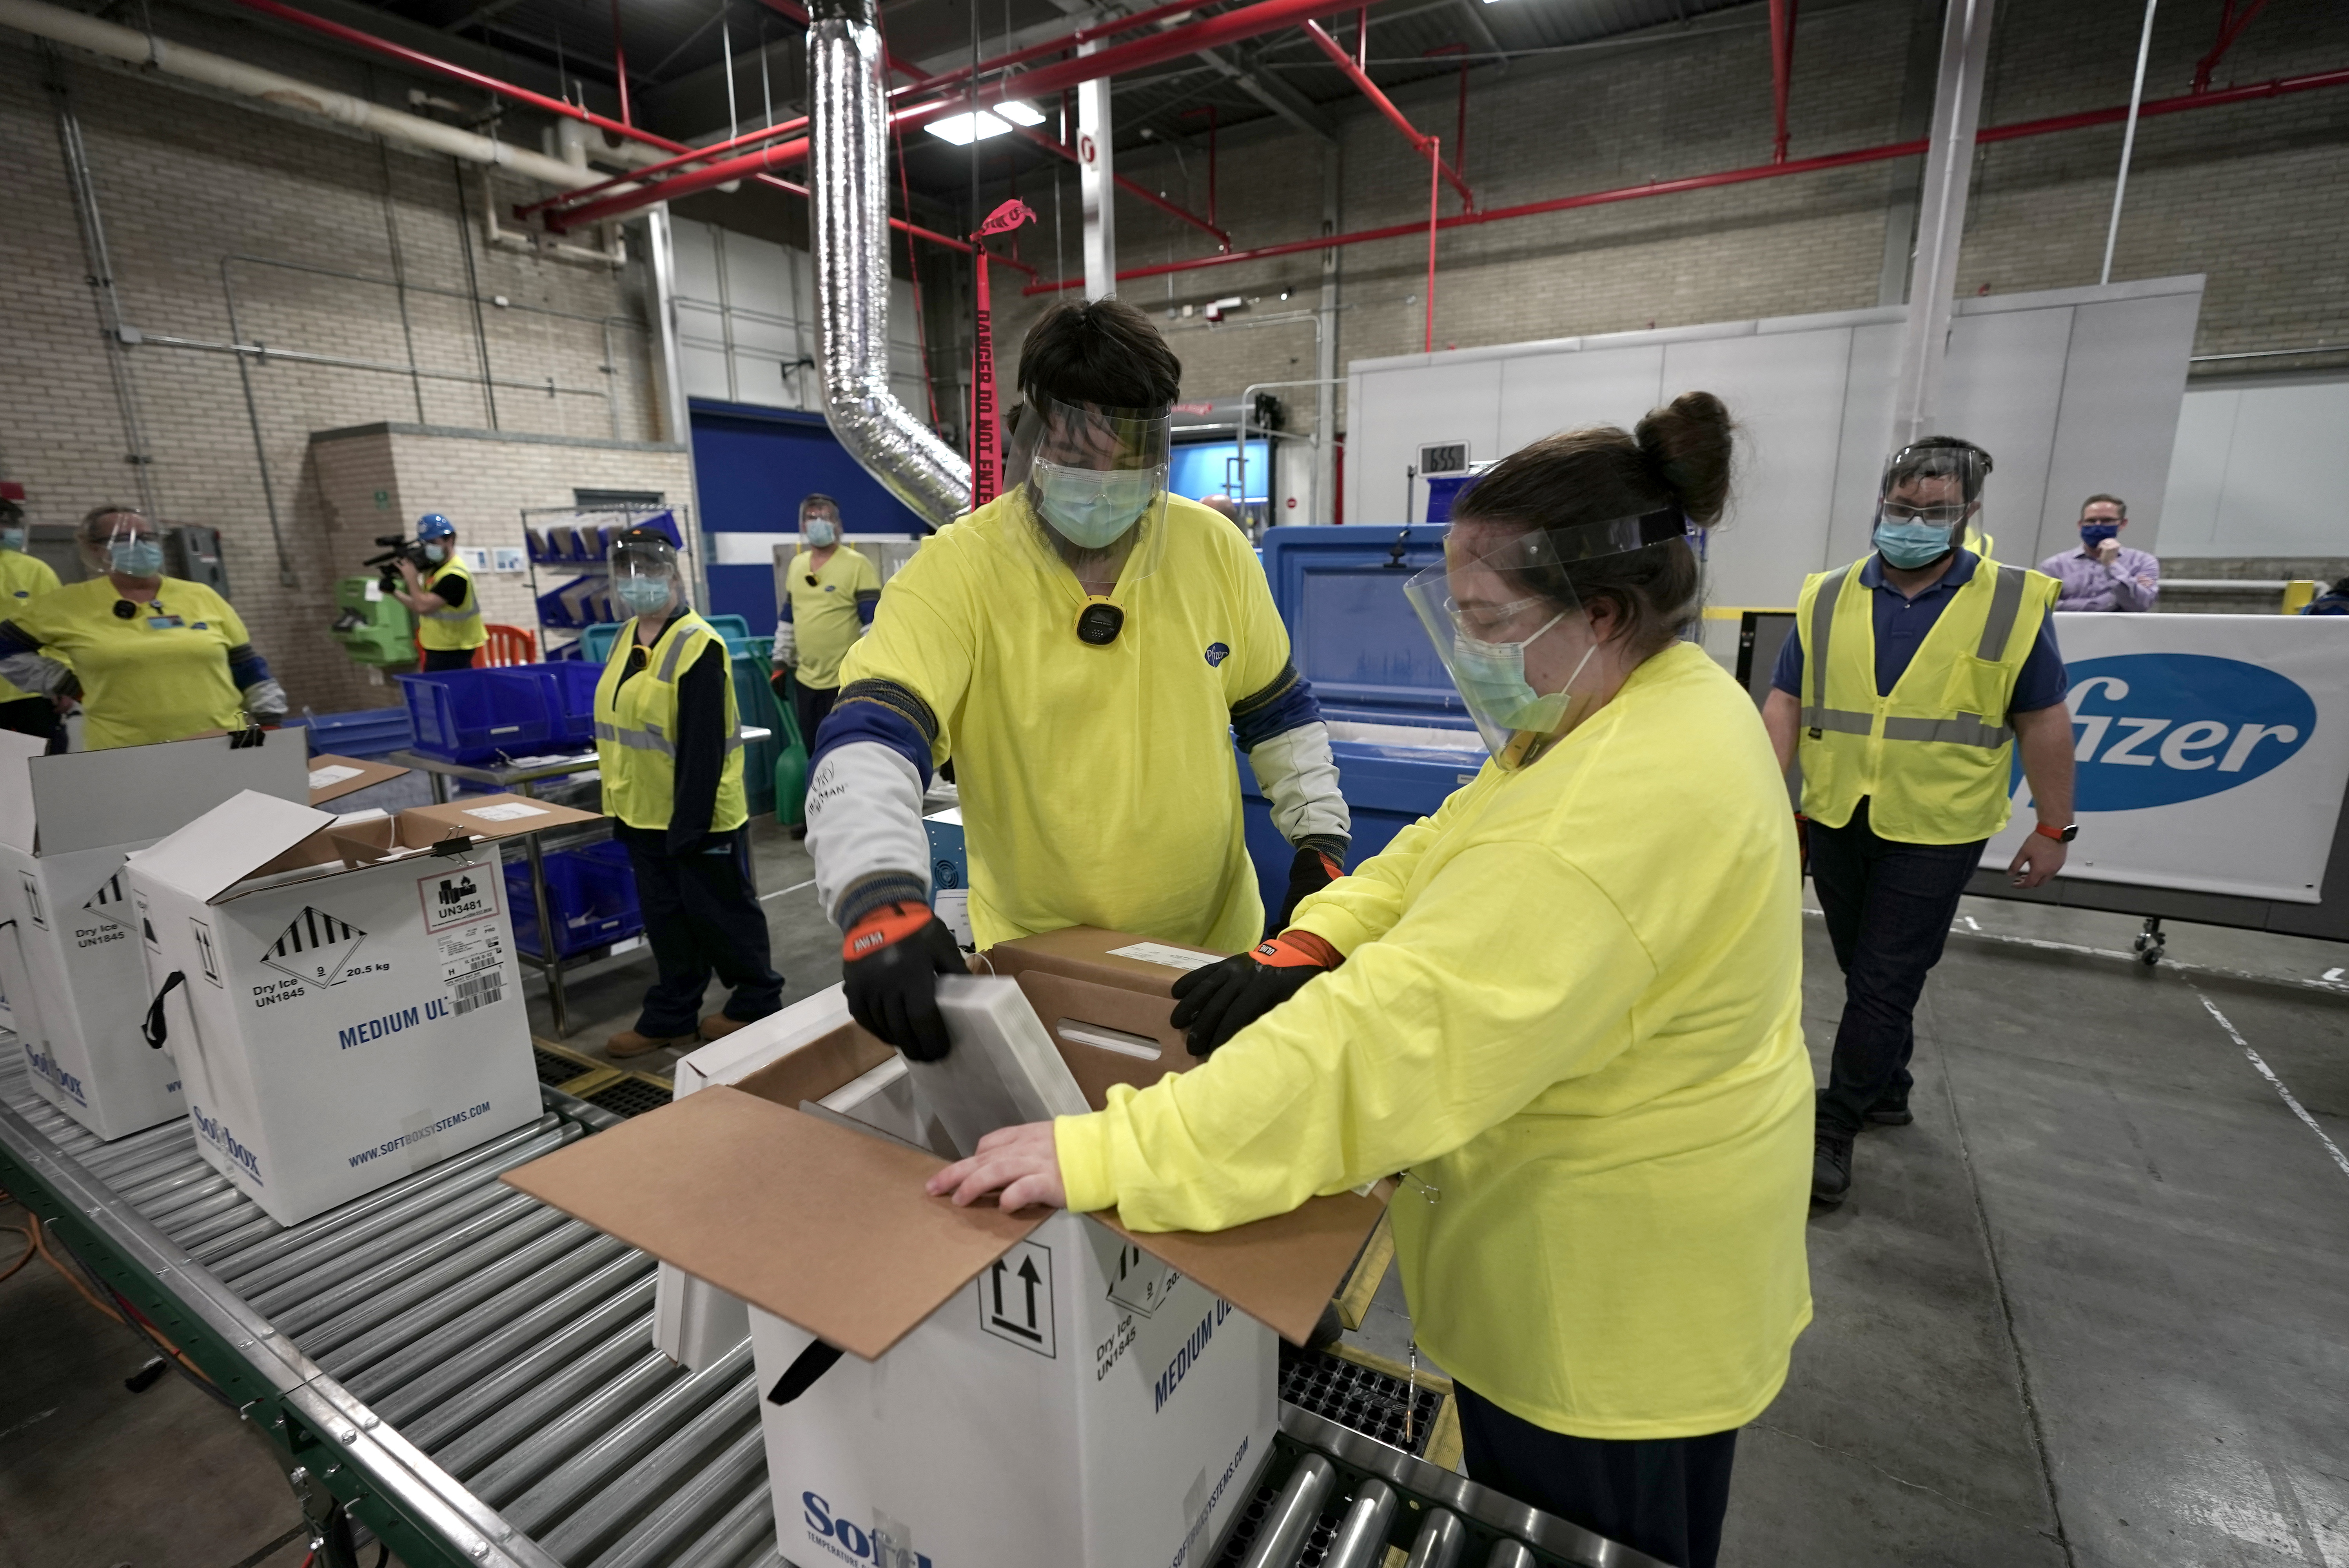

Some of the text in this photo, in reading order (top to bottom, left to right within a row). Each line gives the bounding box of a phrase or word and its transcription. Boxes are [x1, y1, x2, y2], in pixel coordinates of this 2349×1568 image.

[978, 310, 994, 506] DANGER DO NOT ENTE
[1207, 646, 1228, 668] Pfizer
[2061, 676, 2299, 774] fizer
[439, 900, 482, 918] UN3481
[75, 924, 118, 937] Dry Ice
[78, 931, 125, 948] UN1845
[1259, 944, 1275, 955] ULINE
[317, 966, 325, 975] 9
[347, 965, 372, 977] 20.5
[253, 978, 298, 996] Dry Ice
[256, 987, 305, 1007] UN1845
[338, 996, 449, 1050] MEDIUM UL
[193, 1105, 261, 1178] Sofbox
[348, 1101, 490, 1168] WWW.SOFTBOXSYSTEMS.COM
[1166, 1272, 1182, 1292] 20.
[1096, 1314, 1132, 1362] Dry Ice
[1097, 1326, 1136, 1382] UN1845
[1155, 1310, 1212, 1415] MEDIUM
